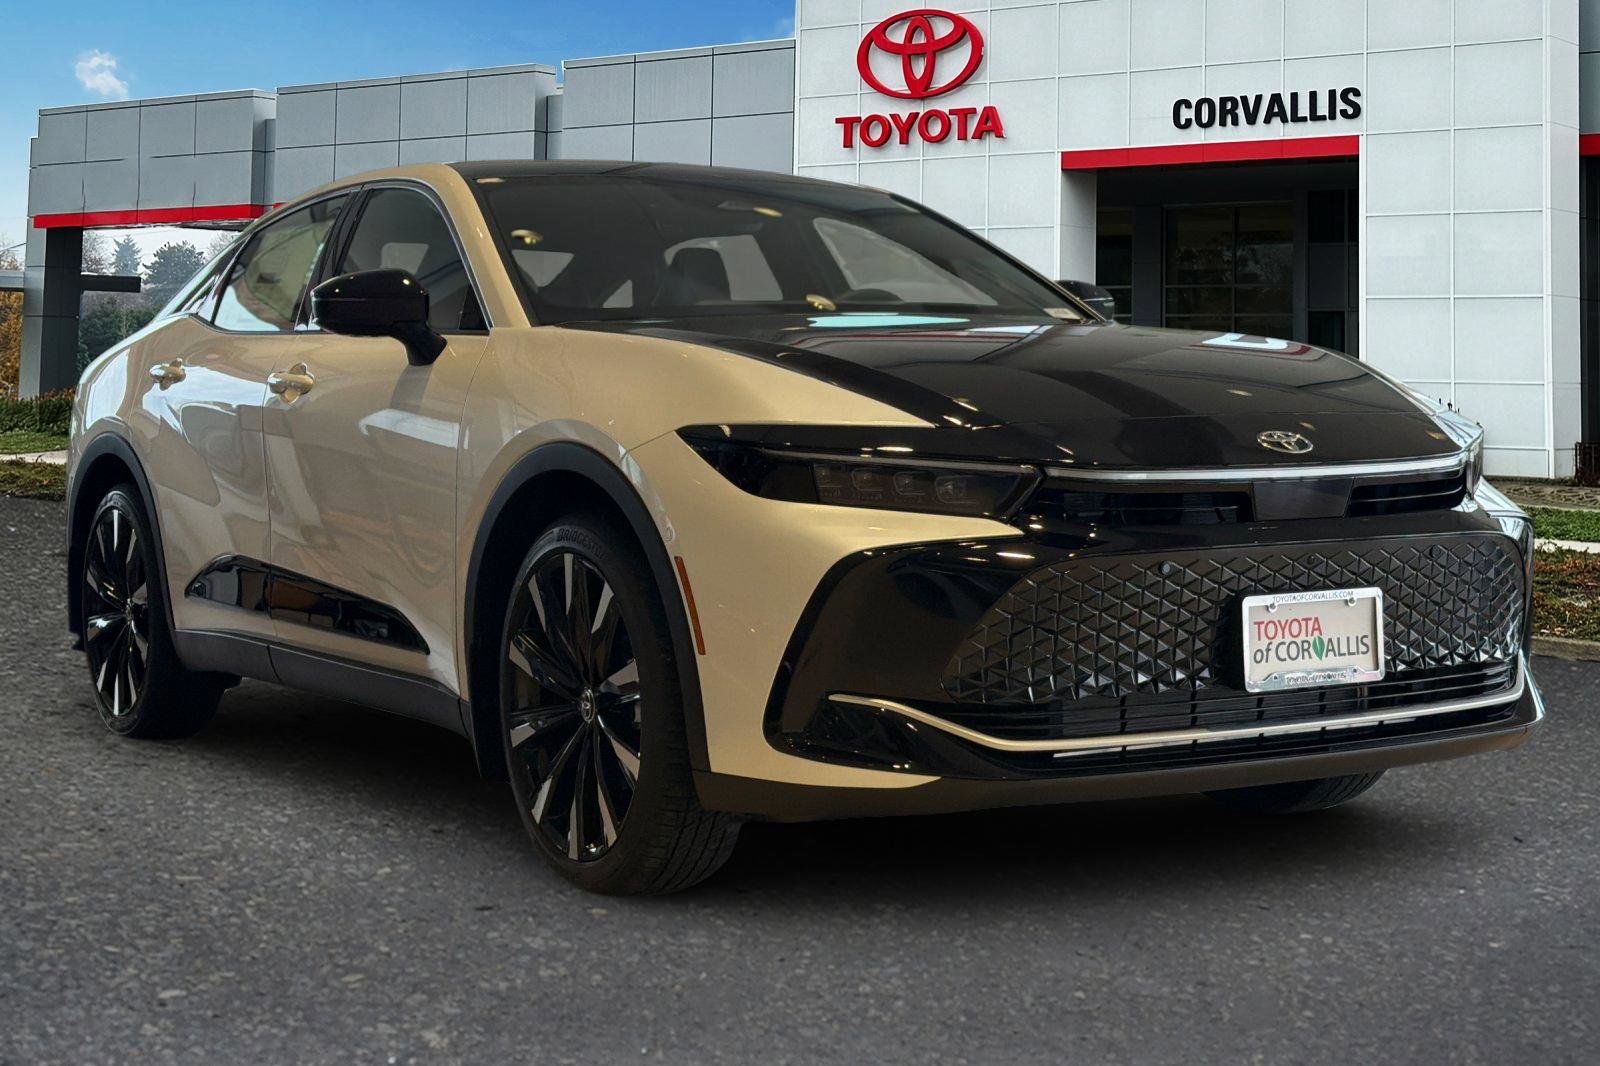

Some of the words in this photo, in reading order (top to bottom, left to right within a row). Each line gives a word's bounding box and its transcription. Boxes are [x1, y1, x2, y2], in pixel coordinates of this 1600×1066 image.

[1172, 86, 1362, 130] CORVALLIS
[836, 105, 1005, 149] TOYOTA
[1254, 617, 1323, 641] TOYOTA
[1253, 641, 1273, 664] of
